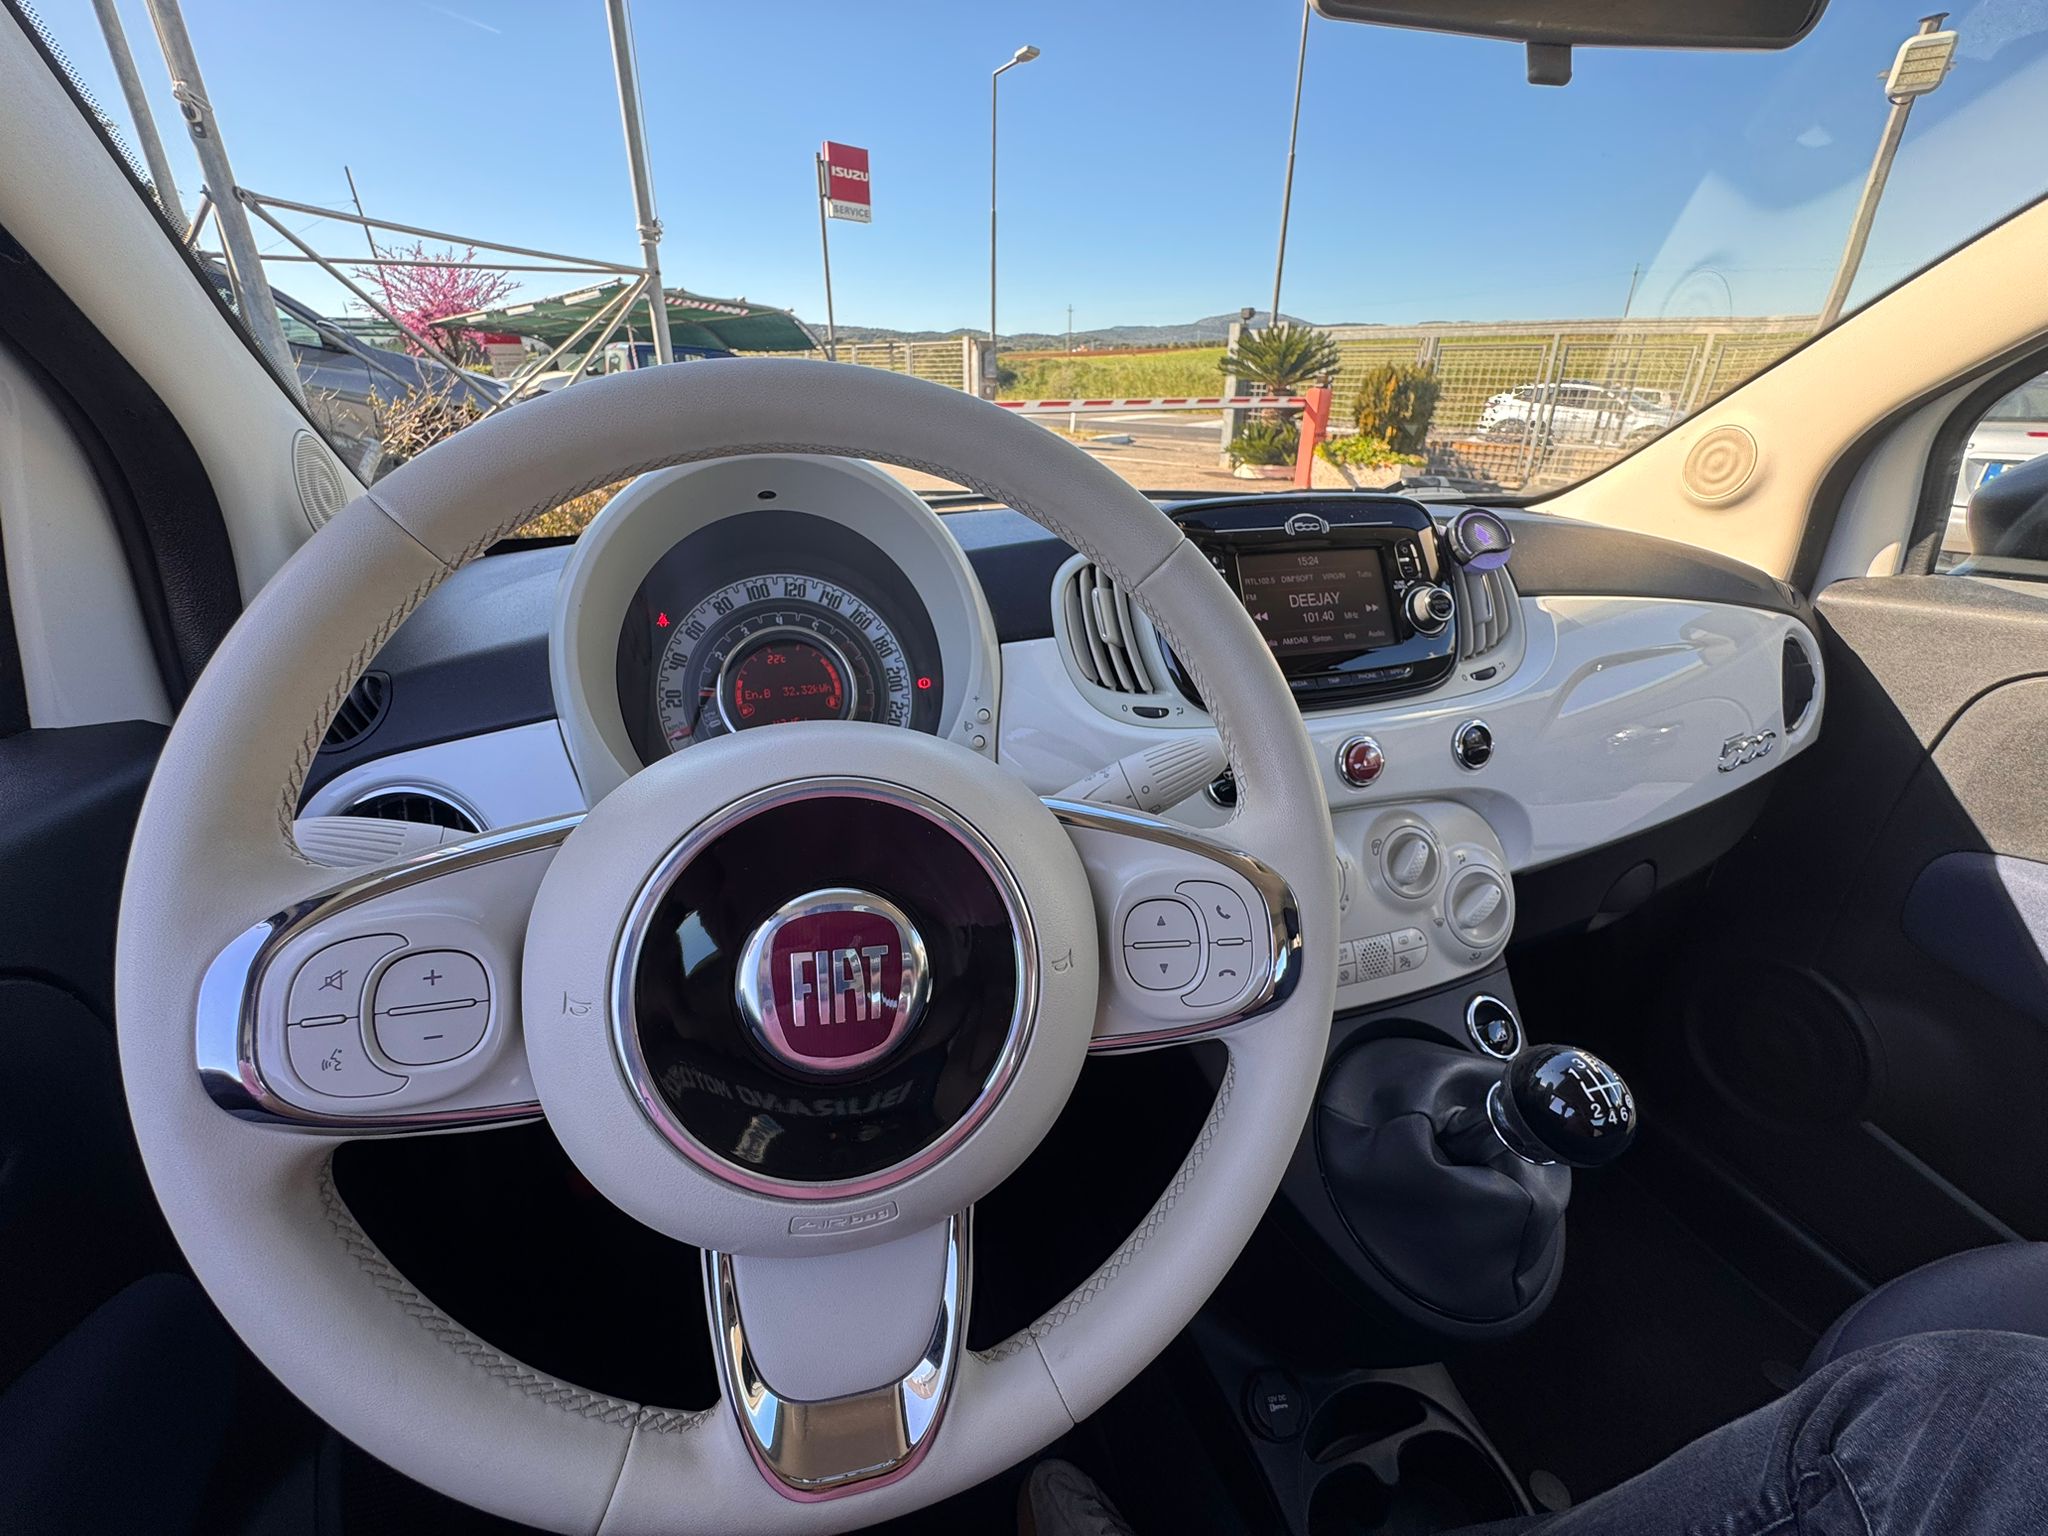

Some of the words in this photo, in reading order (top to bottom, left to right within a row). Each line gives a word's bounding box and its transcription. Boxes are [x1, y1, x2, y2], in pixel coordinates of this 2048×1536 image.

[831, 165, 869, 182] ISUZU
[833, 204, 870, 218] SERVICE
[746, 583, 771, 602] 100
[783, 582, 807, 599] 120
[818, 589, 843, 610] 140
[1288, 592, 1341, 608] DEEJAY
[712, 596, 735, 616] 80
[849, 608, 873, 631] 160
[1302, 610, 1335, 623] 101.40
[685, 619, 707, 641] 60
[872, 635, 894, 659] 180
[669, 652, 688, 671] 40
[886, 666, 903, 692] 200
[665, 689, 683, 708] 20
[888, 700, 904, 727] 220
[789, 943, 889, 1027] FIAT
[1571, 1058, 1586, 1069] 3
[1568, 1068, 1580, 1080] 1
[1590, 1103, 1603, 1118] 2
[1608, 1110, 1617, 1124] 4
[1620, 1107, 1628, 1121] 6
